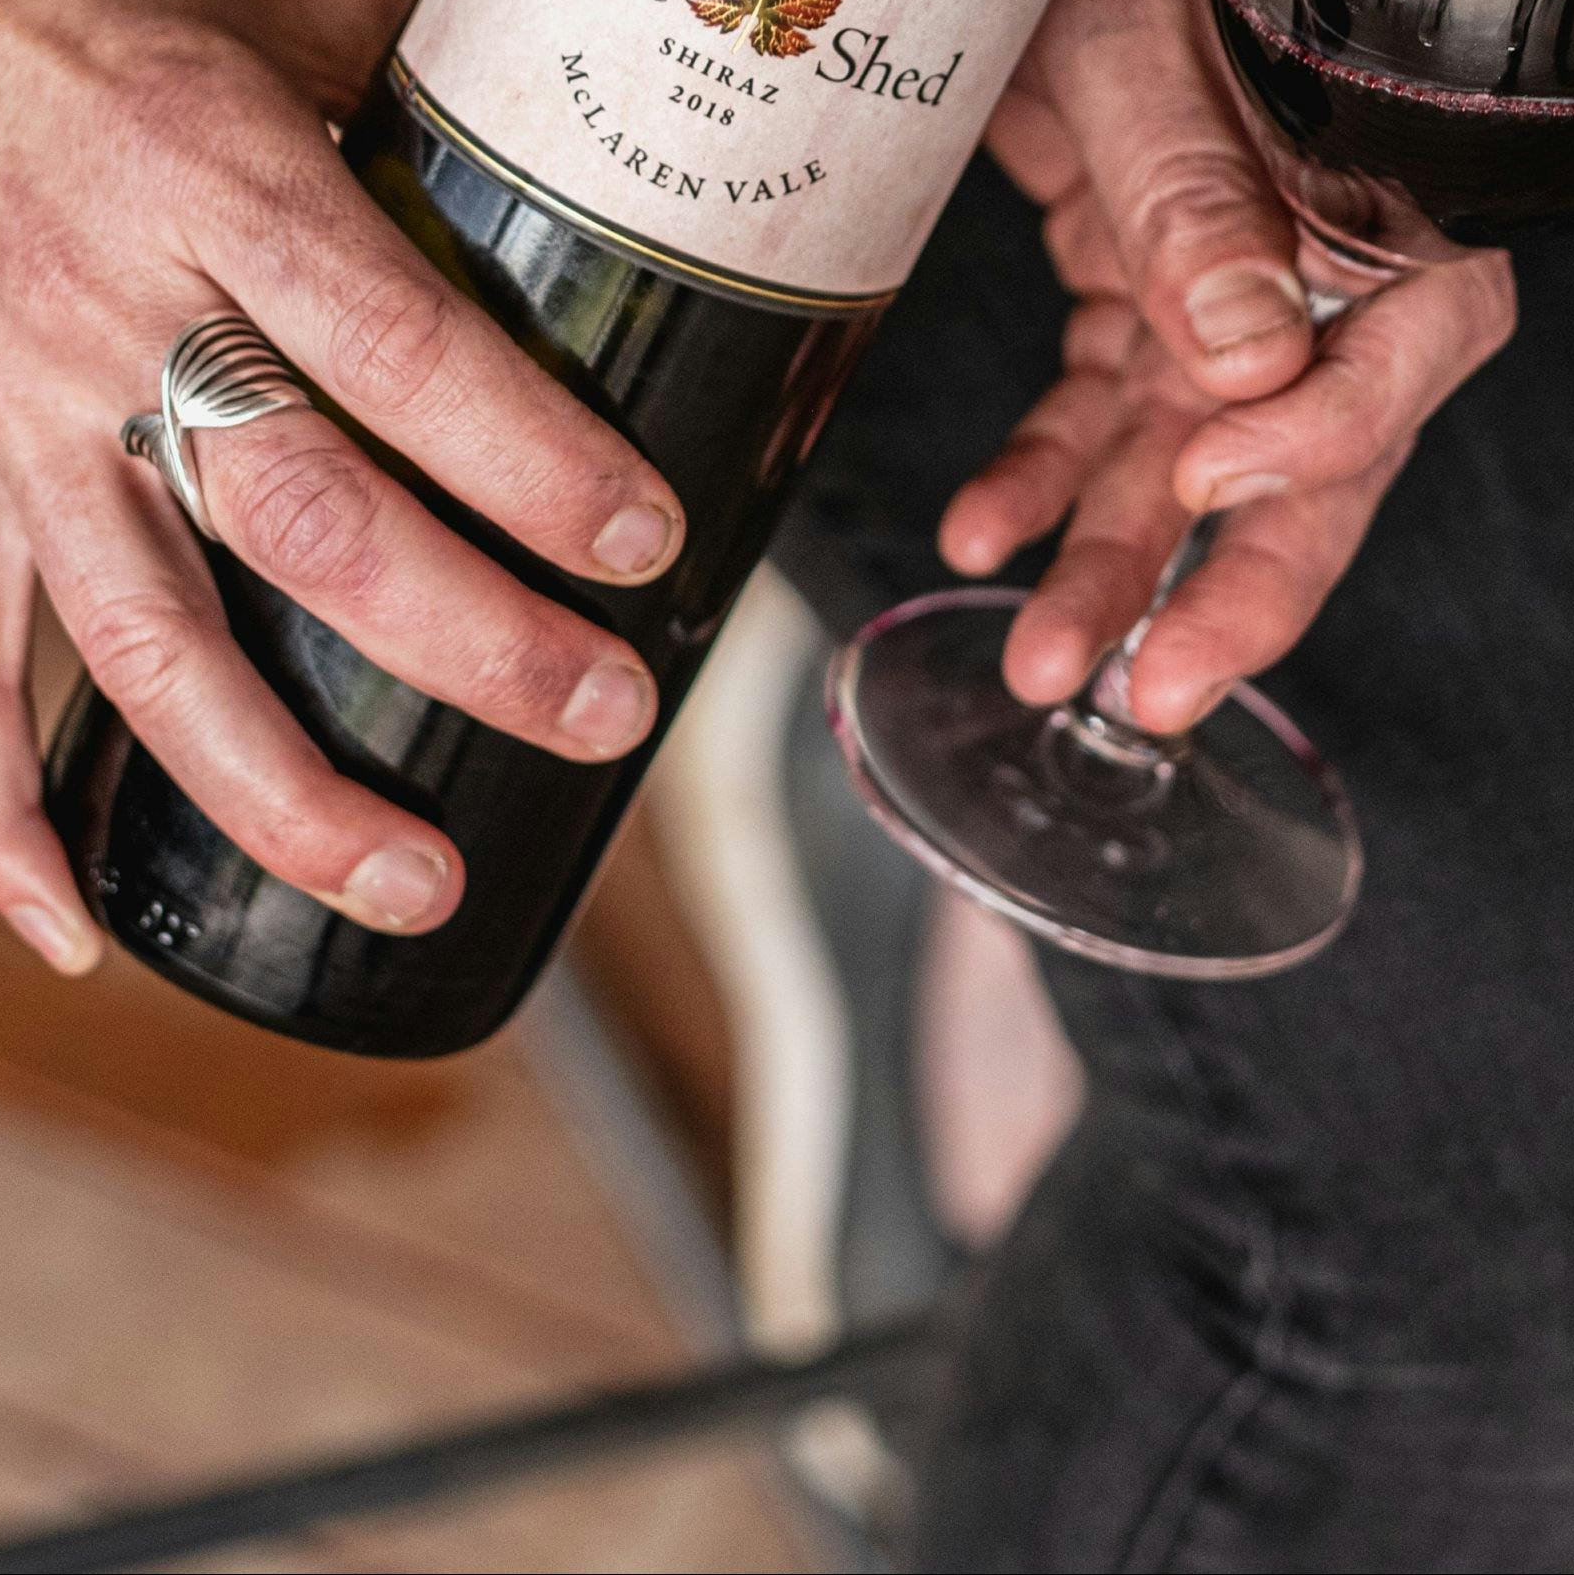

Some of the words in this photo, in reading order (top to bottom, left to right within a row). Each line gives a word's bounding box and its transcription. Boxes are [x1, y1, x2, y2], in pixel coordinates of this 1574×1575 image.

[658, 37, 781, 105] SHIRAZ
[815, 27, 965, 107] Shed
[561, 49, 707, 203] McLAREN
[725, 159, 828, 204] VALE
[667, 85, 737, 127] 2018
